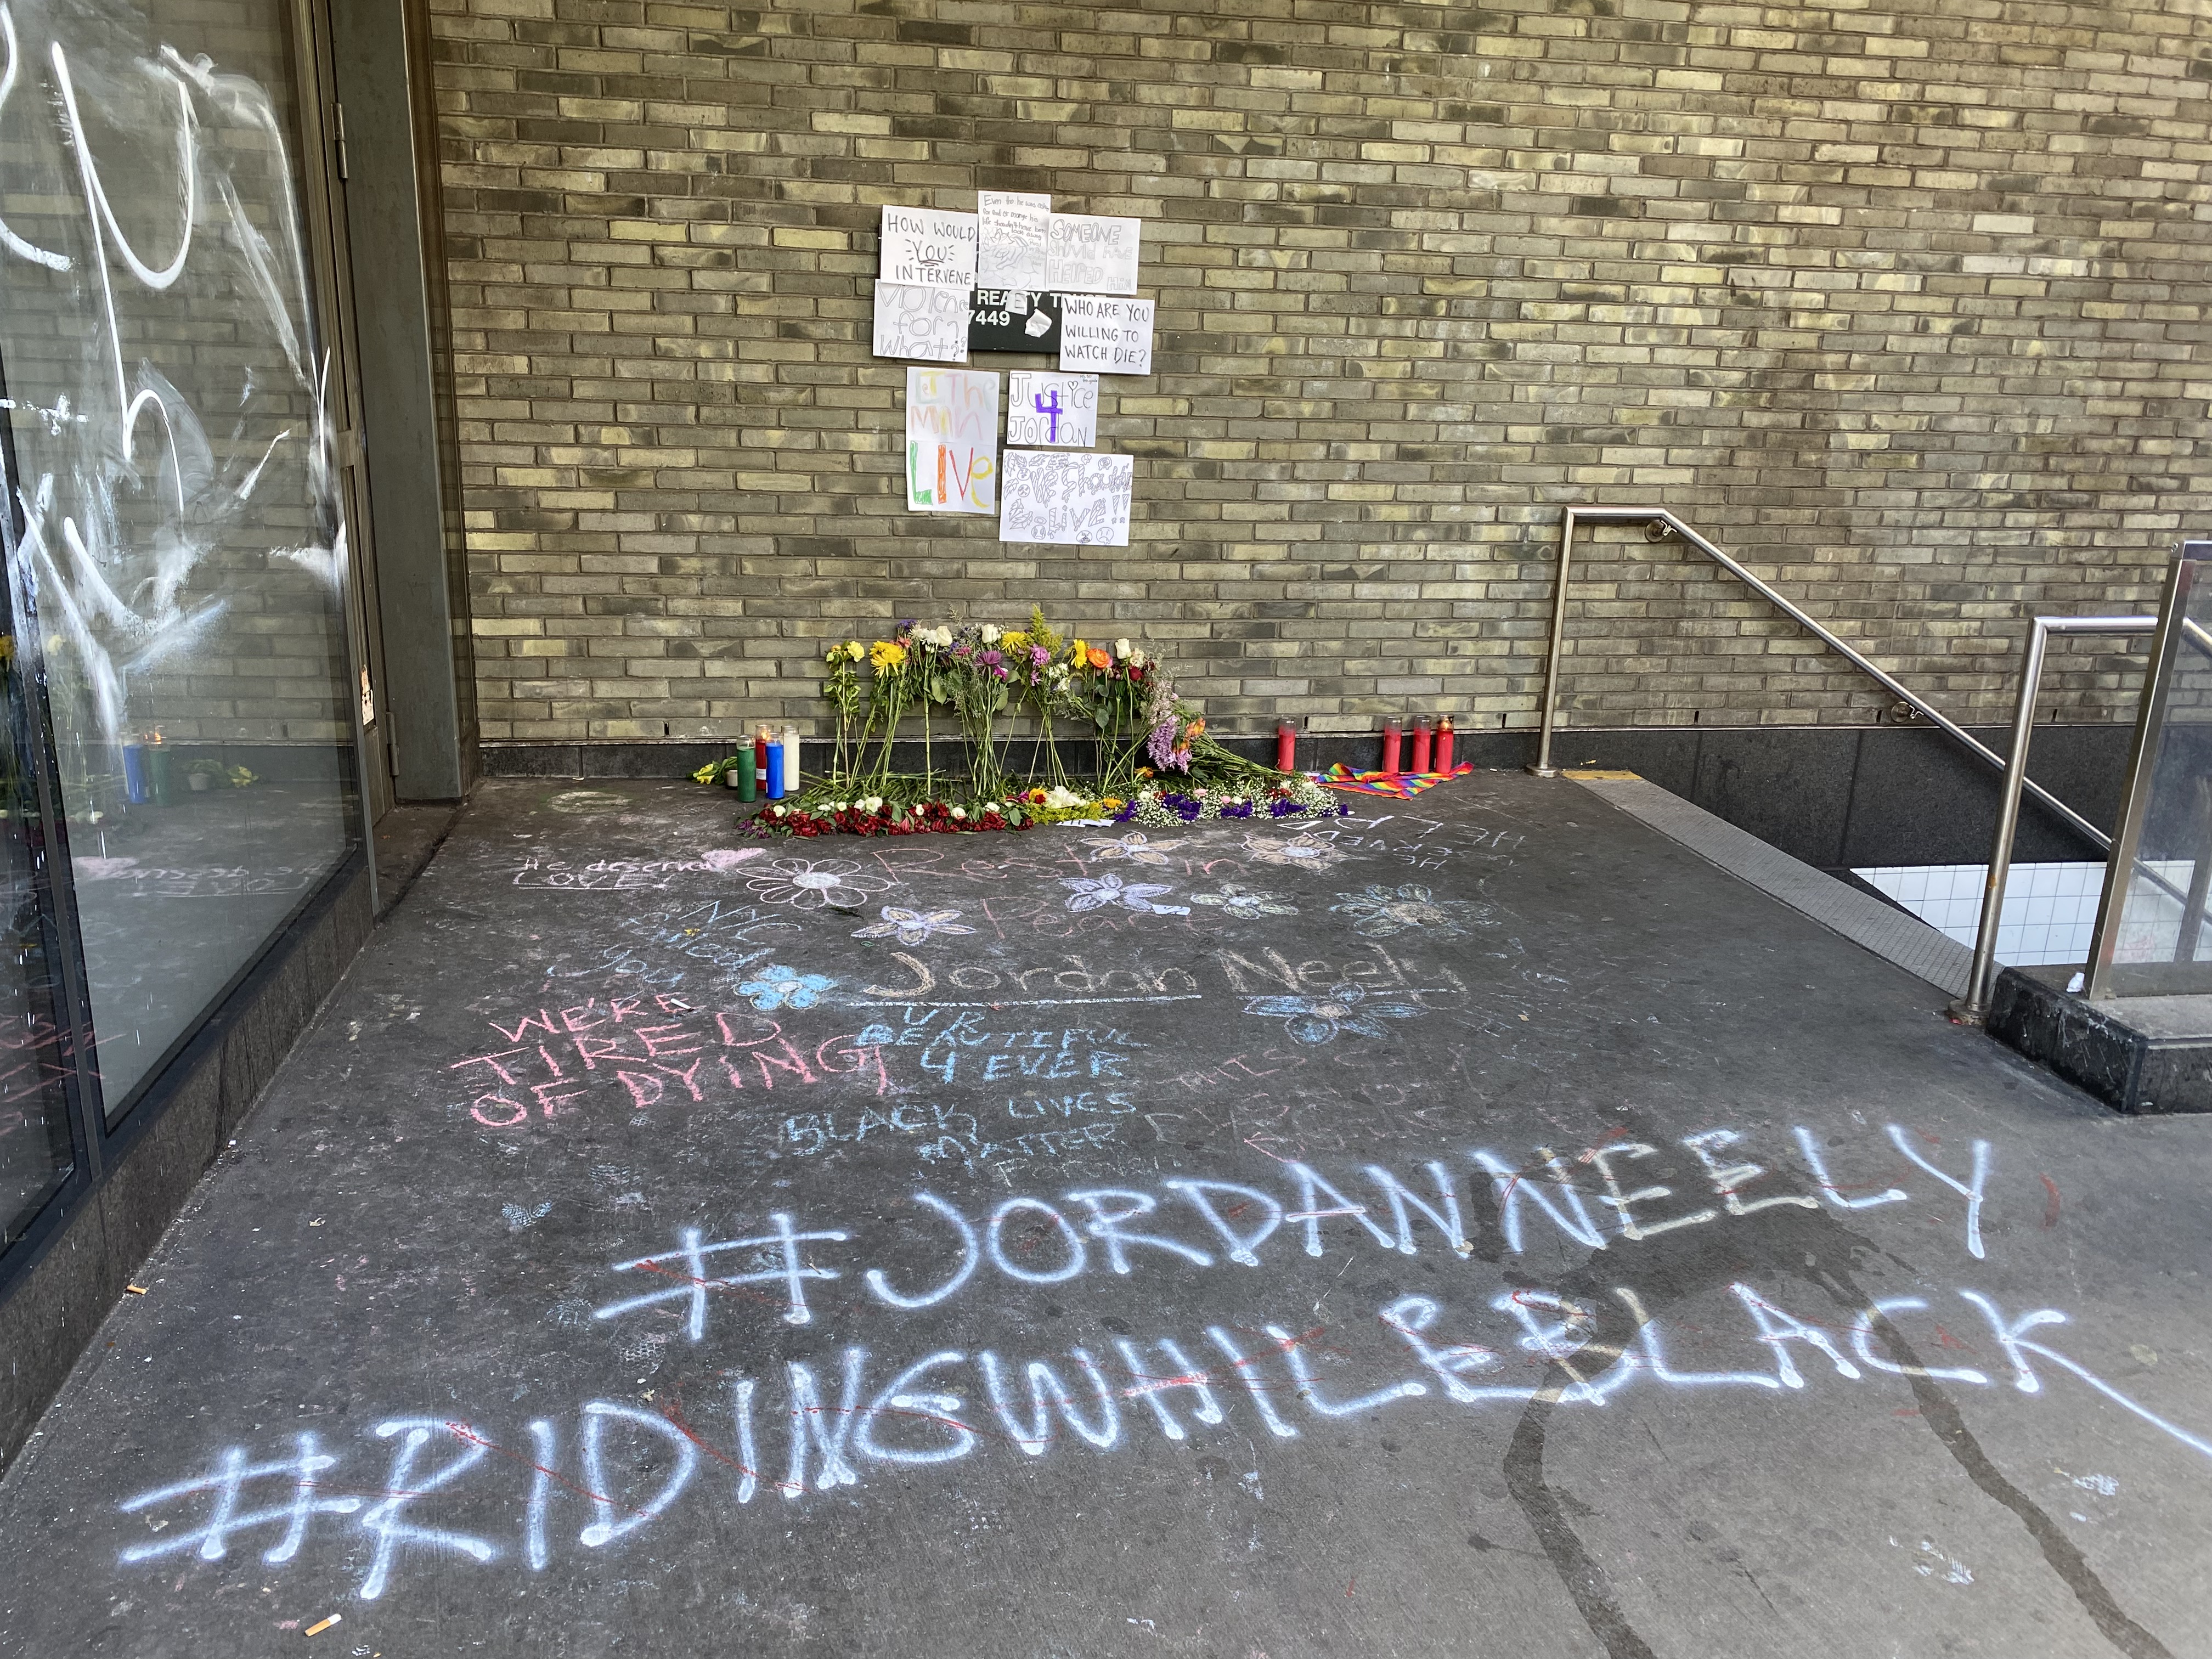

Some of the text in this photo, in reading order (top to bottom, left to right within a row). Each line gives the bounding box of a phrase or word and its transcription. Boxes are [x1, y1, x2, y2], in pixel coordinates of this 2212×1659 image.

[984, 195, 1002, 206] Even
[1017, 195, 1024, 206] he
[888, 213, 976, 242] HOW WOULD
[982, 216, 992, 225] life
[1019, 222, 1032, 232] have
[1050, 219, 1122, 246] SOMEONE
[912, 240, 948, 262] YOU
[896, 264, 972, 285] INTERVENE
[1065, 297, 1093, 316] WHO
[1097, 302, 1119, 318] ARE
[1126, 303, 1149, 321] YOU
[1065, 324, 1139, 343] WILLING TO
[1064, 345, 1147, 368] WATCH DIE?
[1035, 390, 1063, 443] 4
[862, 952, 1198, 997] Jordan
[450, 1012, 782, 1085] TIRED
[616, 1034, 888, 1108] DYING
[920, 1047, 1130, 1085] 4 EVER
[470, 1077, 588, 1127] OF
[786, 1092, 1137, 1158] BLACK LIVES
[591, 1120, 1993, 1342] #JORDANNEELY
[117, 1281, 2212, 1602] #RIDINGWHILEBLACK
